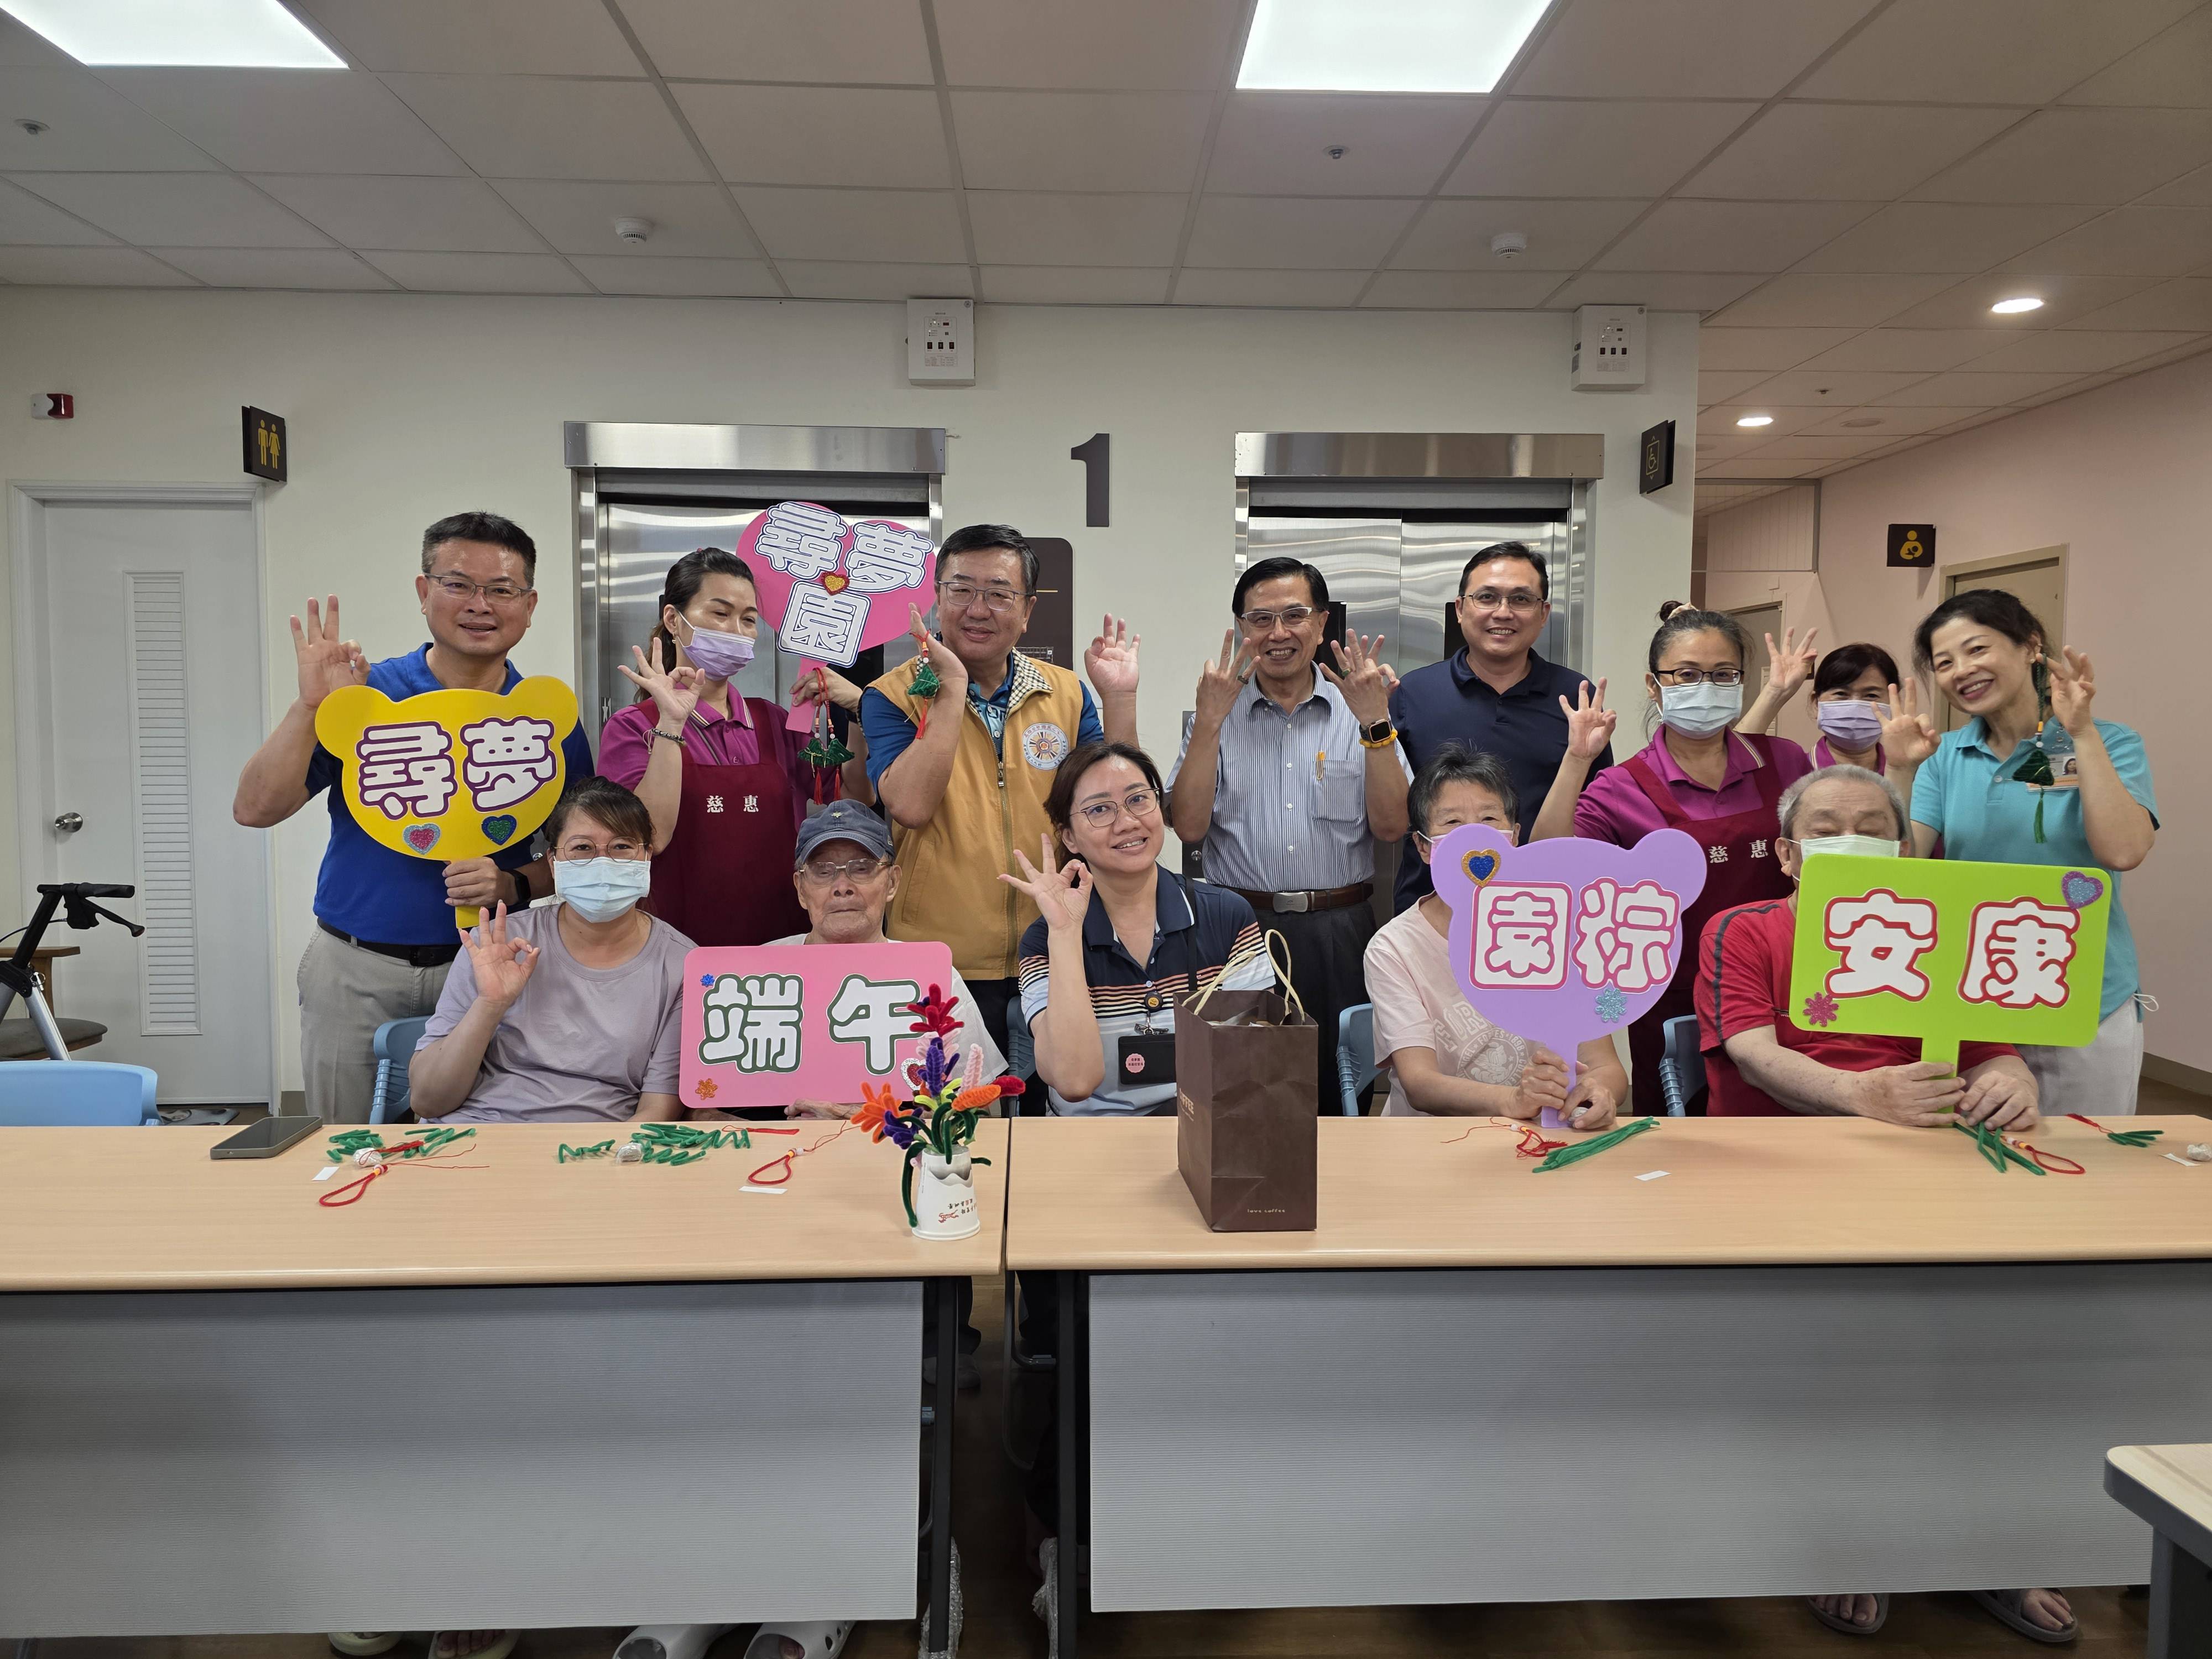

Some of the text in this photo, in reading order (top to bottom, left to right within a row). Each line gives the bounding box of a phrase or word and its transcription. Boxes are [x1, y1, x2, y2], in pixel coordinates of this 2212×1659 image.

[1070, 432, 1110, 528] 1
[754, 501, 935, 594] 尋夢
[776, 580, 872, 668] 園
[356, 716, 557, 820] 尋夢
[706, 795, 759, 813] 慈惠
[1708, 839, 1768, 863] 慈惠
[1469, 877, 1681, 993] 園粽
[1824, 887, 2080, 1010] 安康
[697, 973, 927, 1076] 端午
[1433, 1000, 1491, 1053] FOR
[1508, 1033, 1525, 1052] 1898
